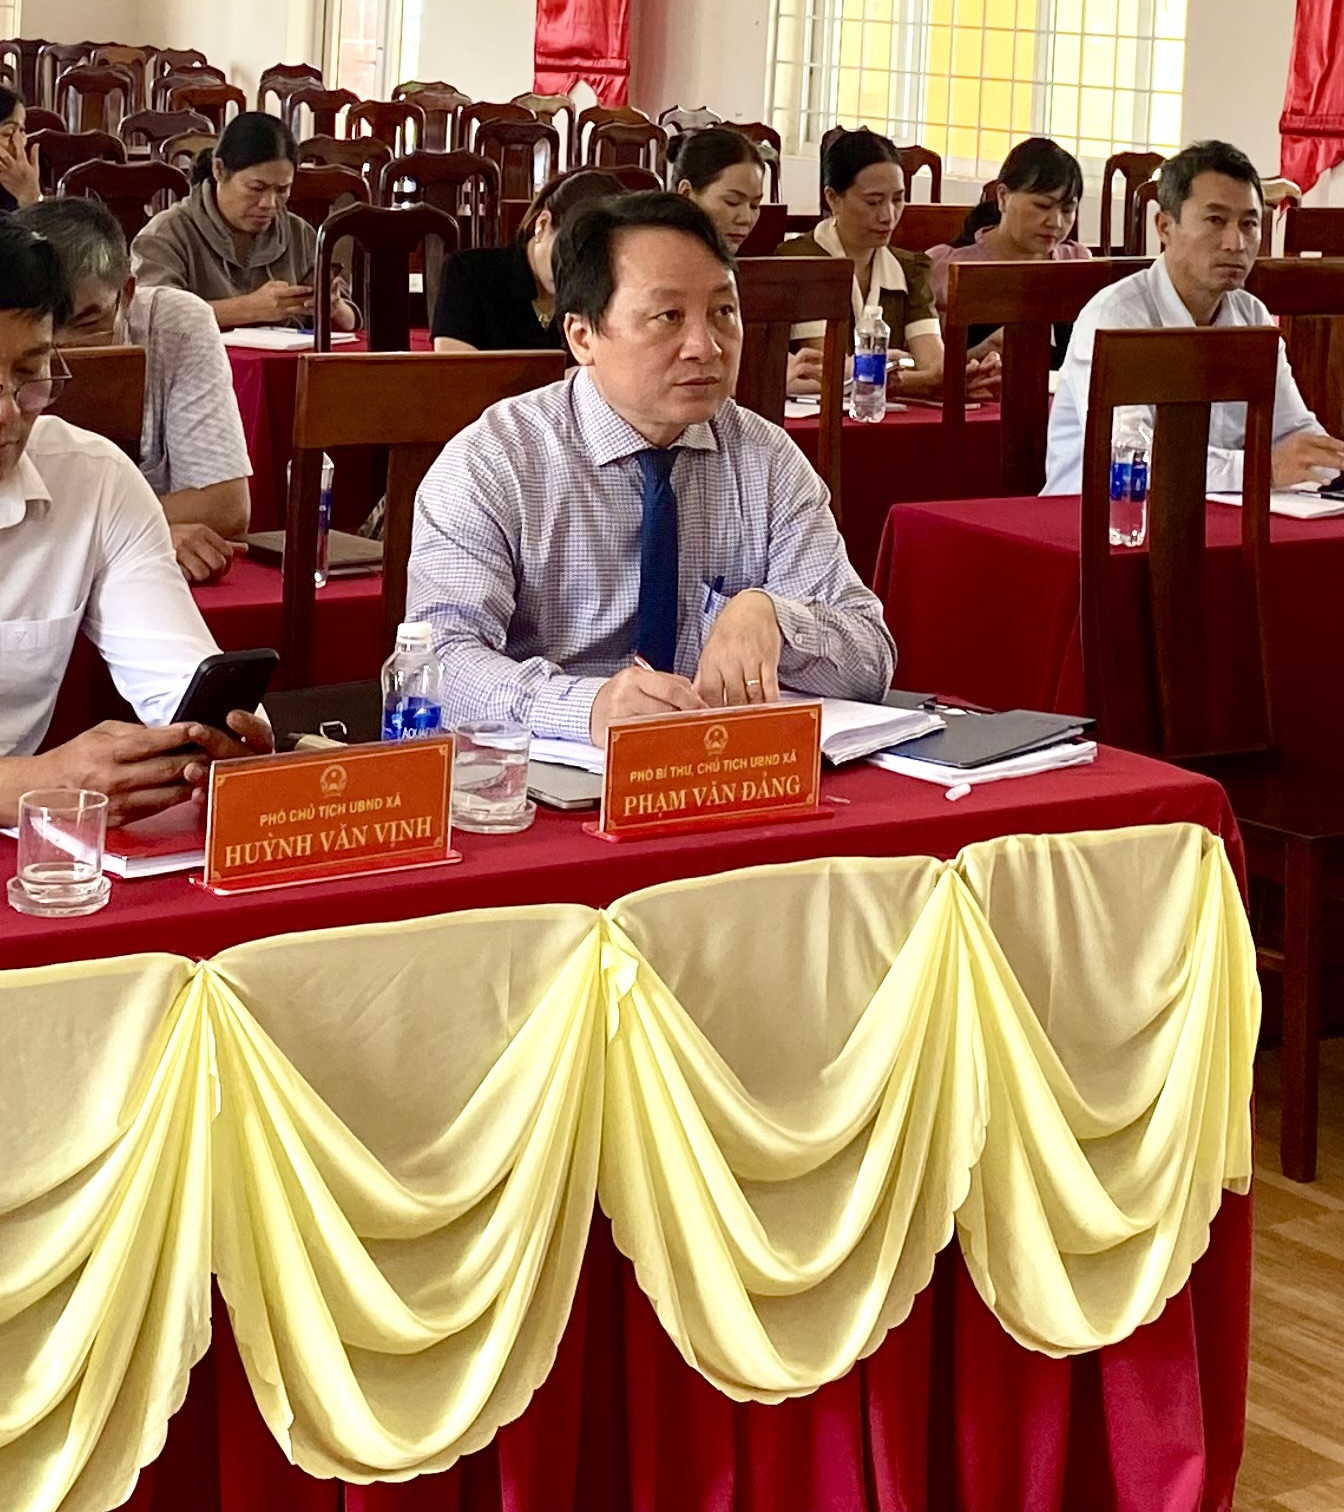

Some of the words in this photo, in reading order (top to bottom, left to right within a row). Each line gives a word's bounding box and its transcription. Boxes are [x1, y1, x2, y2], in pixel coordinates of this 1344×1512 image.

[319, 799, 346, 819] TỊCH
[349, 796, 383, 814] UBND
[386, 792, 402, 809] XÃ
[623, 788, 686, 818] PHẠM
[692, 781, 737, 807] VĂN
[224, 831, 313, 868] HUỲNH
[320, 822, 369, 852] VĂN
[374, 815, 433, 848] VỊNH
